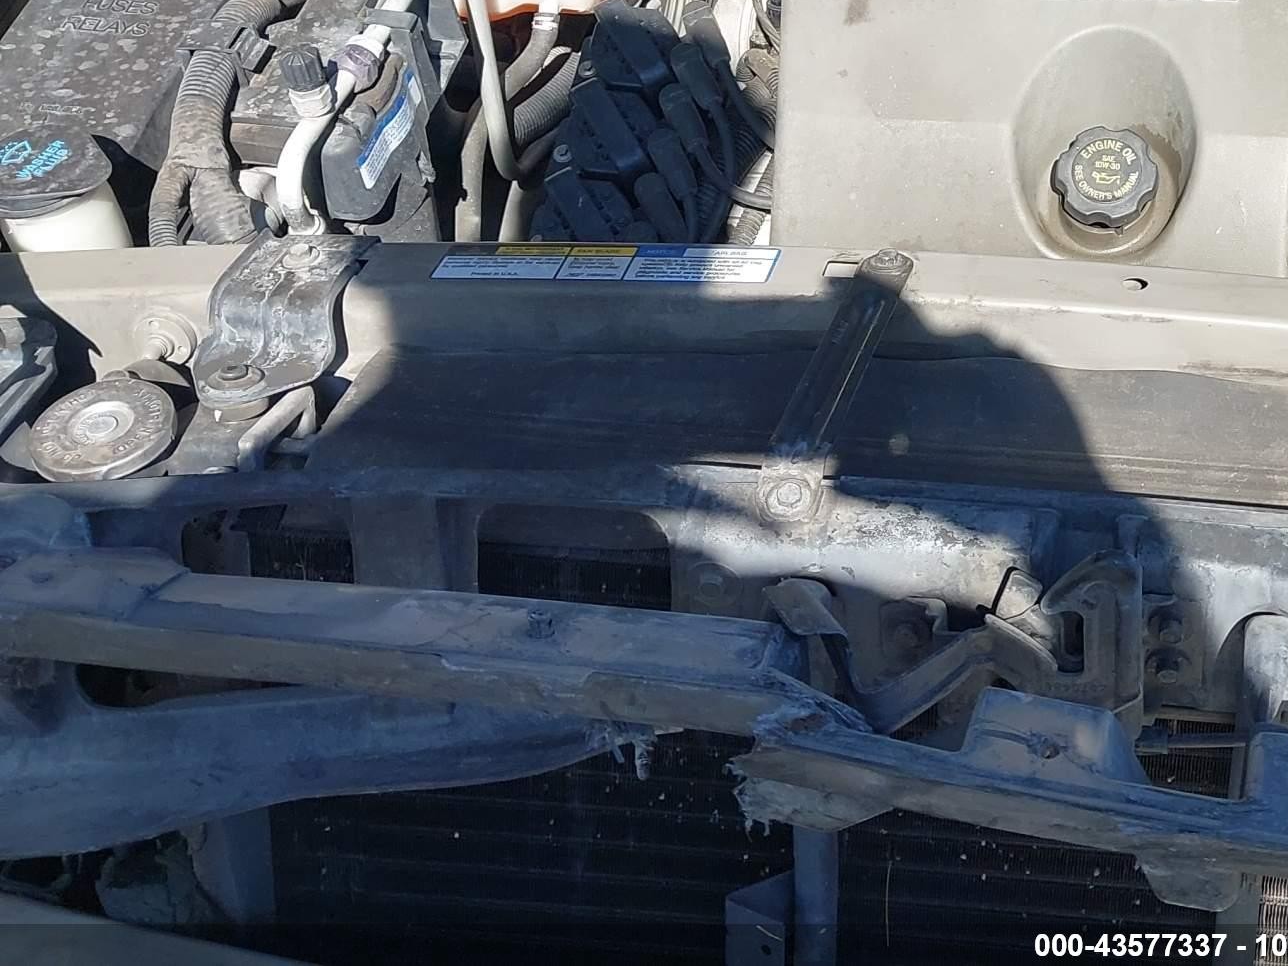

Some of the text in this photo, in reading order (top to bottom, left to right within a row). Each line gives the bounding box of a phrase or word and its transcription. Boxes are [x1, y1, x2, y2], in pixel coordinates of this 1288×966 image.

[61, 15, 151, 36] RELAYS
[15, 139, 65, 181] WASHER
[32, 148, 69, 178] FLUID
[1080, 139, 1137, 165] ENGINE OIL
[1095, 161, 1121, 171] 10W-30
[1074, 164, 1139, 200] SEE OWNER'S MANUAL
